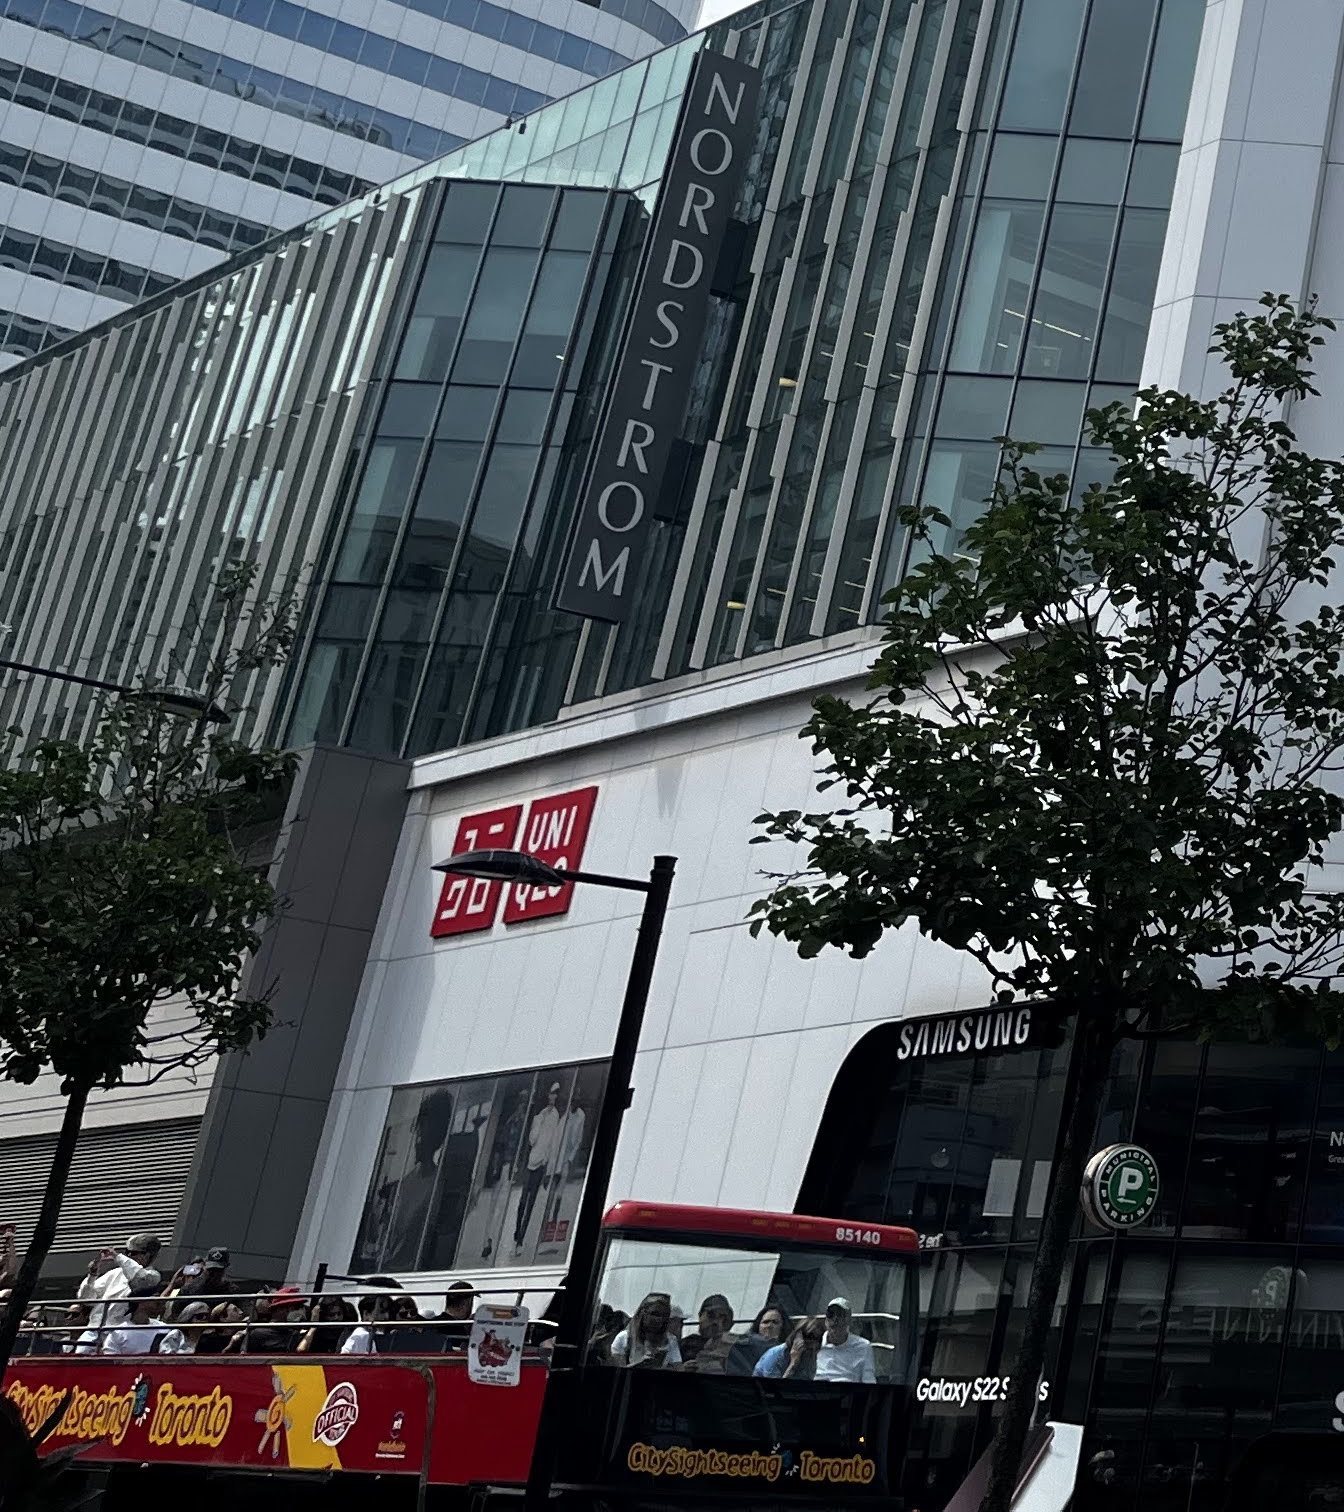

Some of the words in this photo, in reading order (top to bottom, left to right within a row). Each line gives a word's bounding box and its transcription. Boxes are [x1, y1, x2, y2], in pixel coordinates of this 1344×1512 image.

[577, 71, 747, 597] NORDSTROM
[528, 805, 578, 854] UNI
[897, 1008, 1031, 1060] SAMSUNG
[1105, 1151, 1156, 1182] MUNICIPAL
[1101, 1189, 1153, 1223] PARKING
[835, 1227, 881, 1245] 85140
[916, 1377, 972, 1408] Galaxy
[972, 1377, 1000, 1402] S22
[149, 1382, 233, 1448] Toronto
[317, 1406, 356, 1434] OFFICIAL
[628, 1442, 783, 1482] CitySightseeing
[800, 1451, 876, 1484] Toronto
